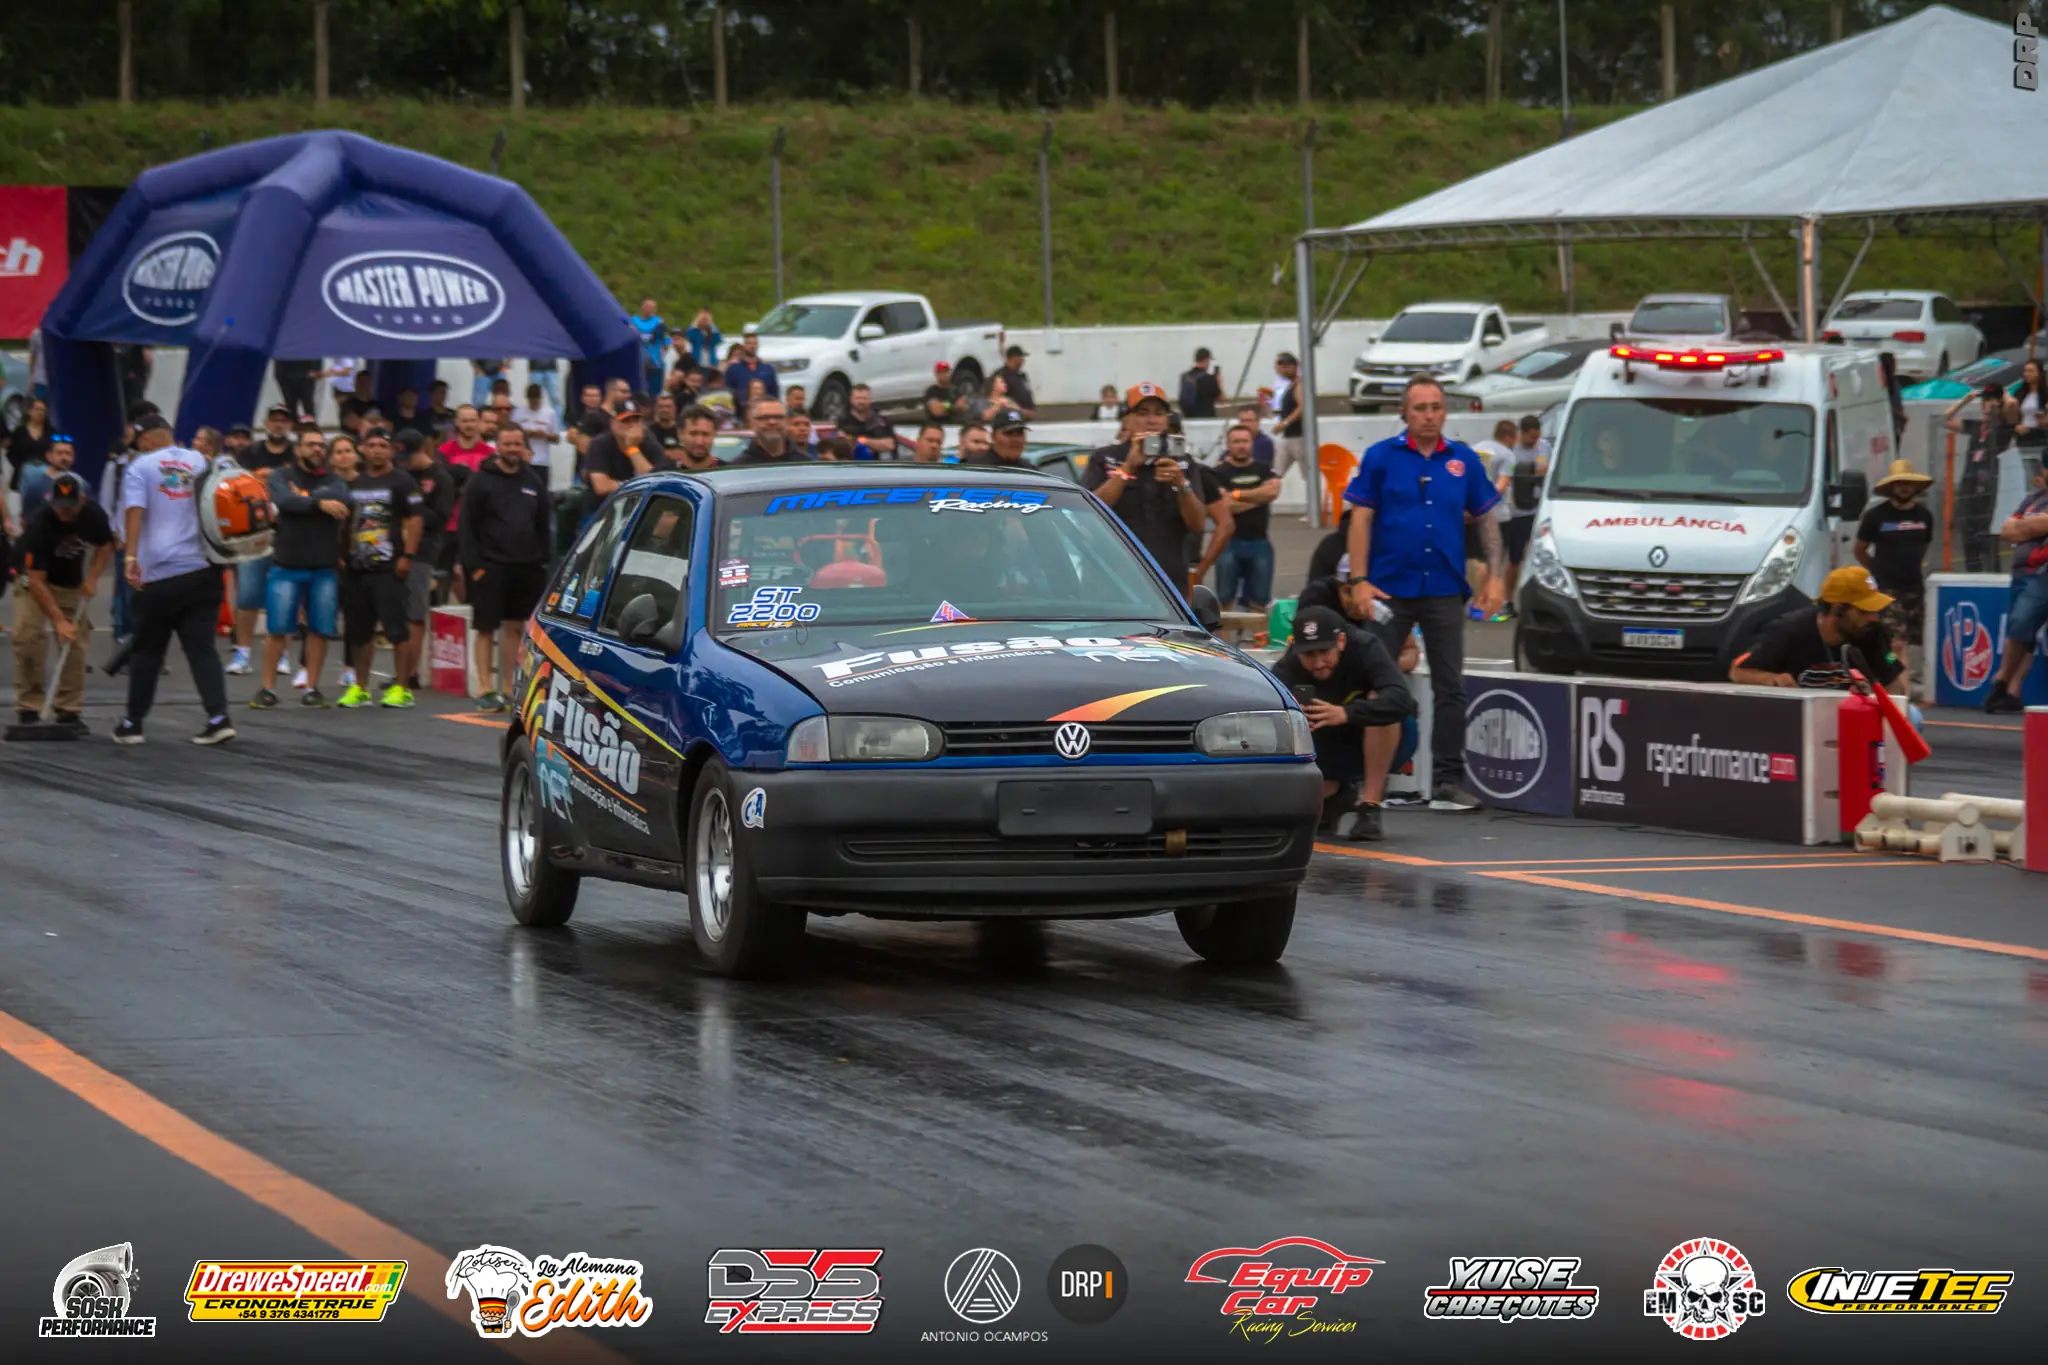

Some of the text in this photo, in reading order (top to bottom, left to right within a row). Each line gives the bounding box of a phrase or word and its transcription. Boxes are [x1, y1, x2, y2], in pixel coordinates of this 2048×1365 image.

[335, 265, 489, 308] MASTER POWER
[928, 498, 1053, 514] Racing
[1585, 516, 1748, 535] AMBULÂNCIA
[752, 586, 802, 604] ST
[727, 603, 821, 624] 2200
[812, 636, 1121, 680] Fusão
[545, 667, 642, 796] Fusão
[1580, 696, 1629, 782] RS
[1479, 766, 1525, 783] TURBO
